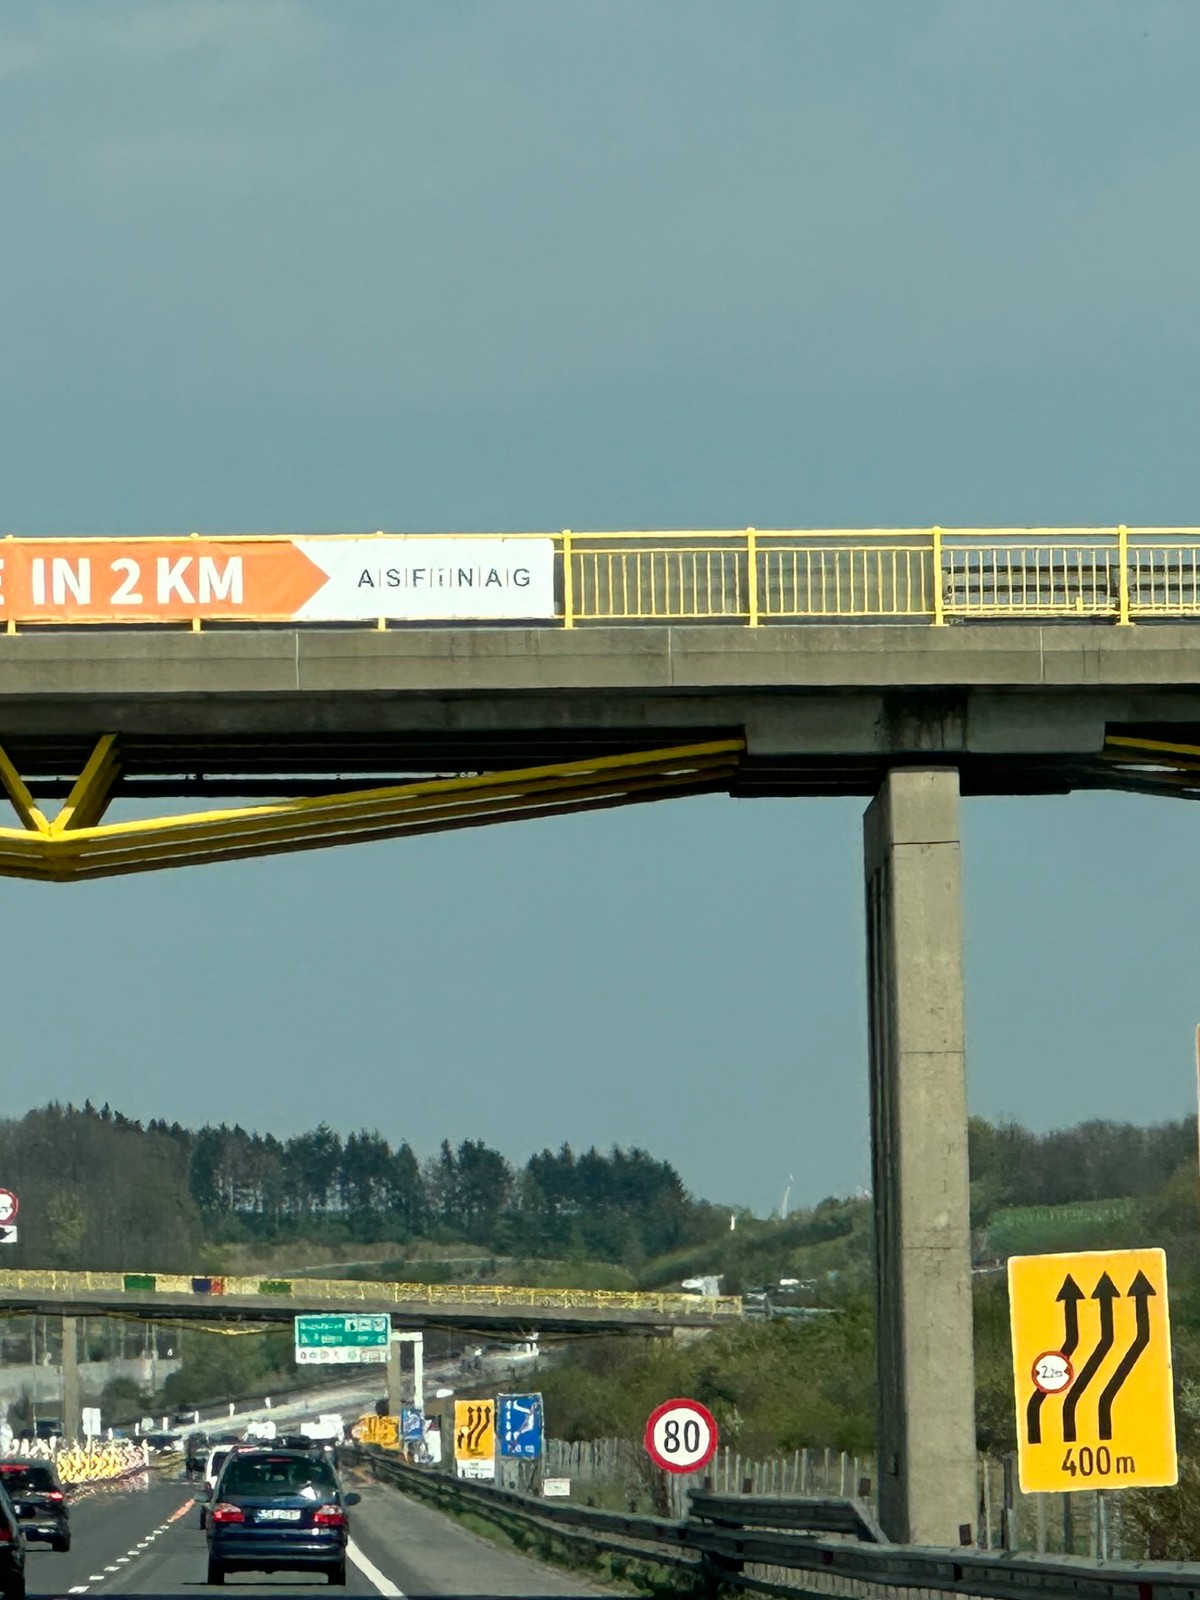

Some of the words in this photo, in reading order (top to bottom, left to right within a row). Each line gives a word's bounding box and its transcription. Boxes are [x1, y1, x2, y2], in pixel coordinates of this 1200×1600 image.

[31, 557, 91, 605] IN
[110, 556, 143, 604] 2
[156, 555, 243, 604] KM
[664, 1419, 700, 1453] 80
